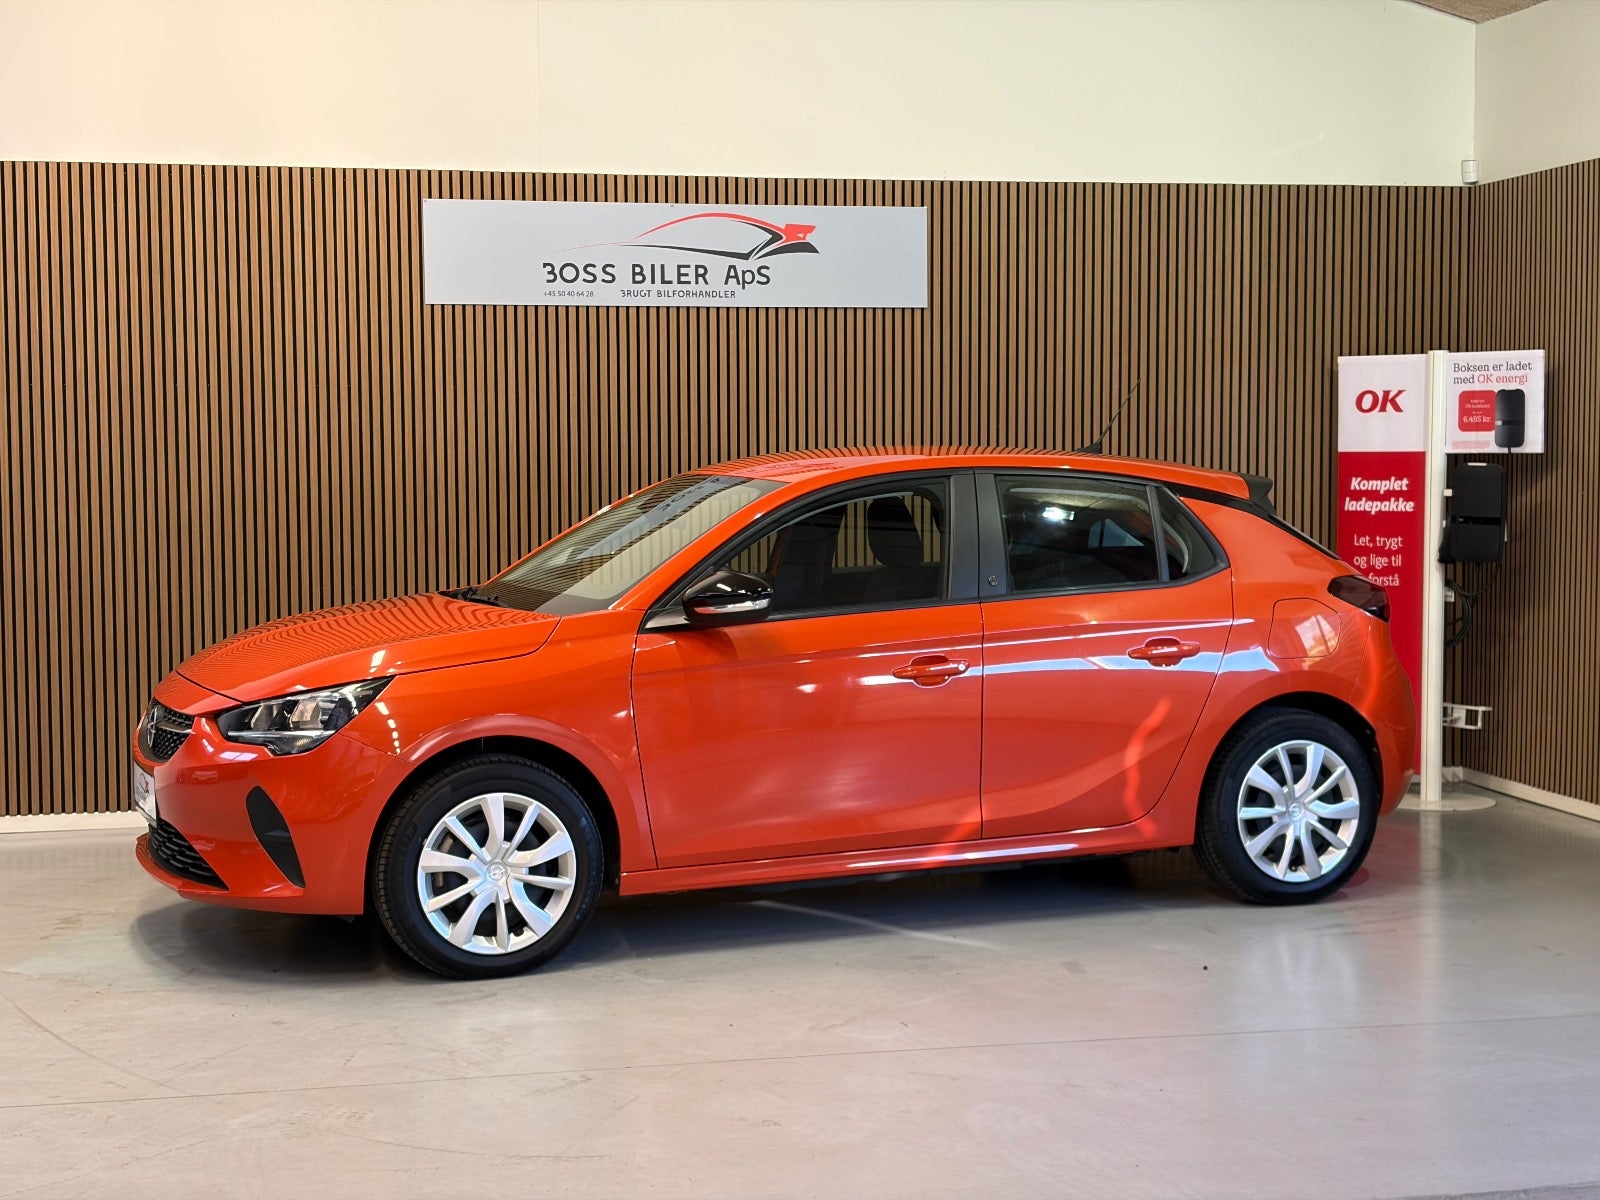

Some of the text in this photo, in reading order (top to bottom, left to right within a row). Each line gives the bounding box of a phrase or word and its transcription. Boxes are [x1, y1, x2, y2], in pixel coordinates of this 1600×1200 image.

[631, 263, 709, 285] BILER
[724, 264, 771, 290] ApS
[585, 290, 594, 298] 28
[657, 289, 736, 299] BILFORHANDLER
[1453, 361, 1533, 373] Boksen er ladet
[1453, 373, 1528, 385] med OK energi
[1355, 389, 1407, 413] OK
[1350, 476, 1409, 495] Komplet
[1344, 496, 1415, 515] ladepakke
[1354, 534, 1403, 550] Let, trygt
[1353, 553, 1402, 570] og lige til
